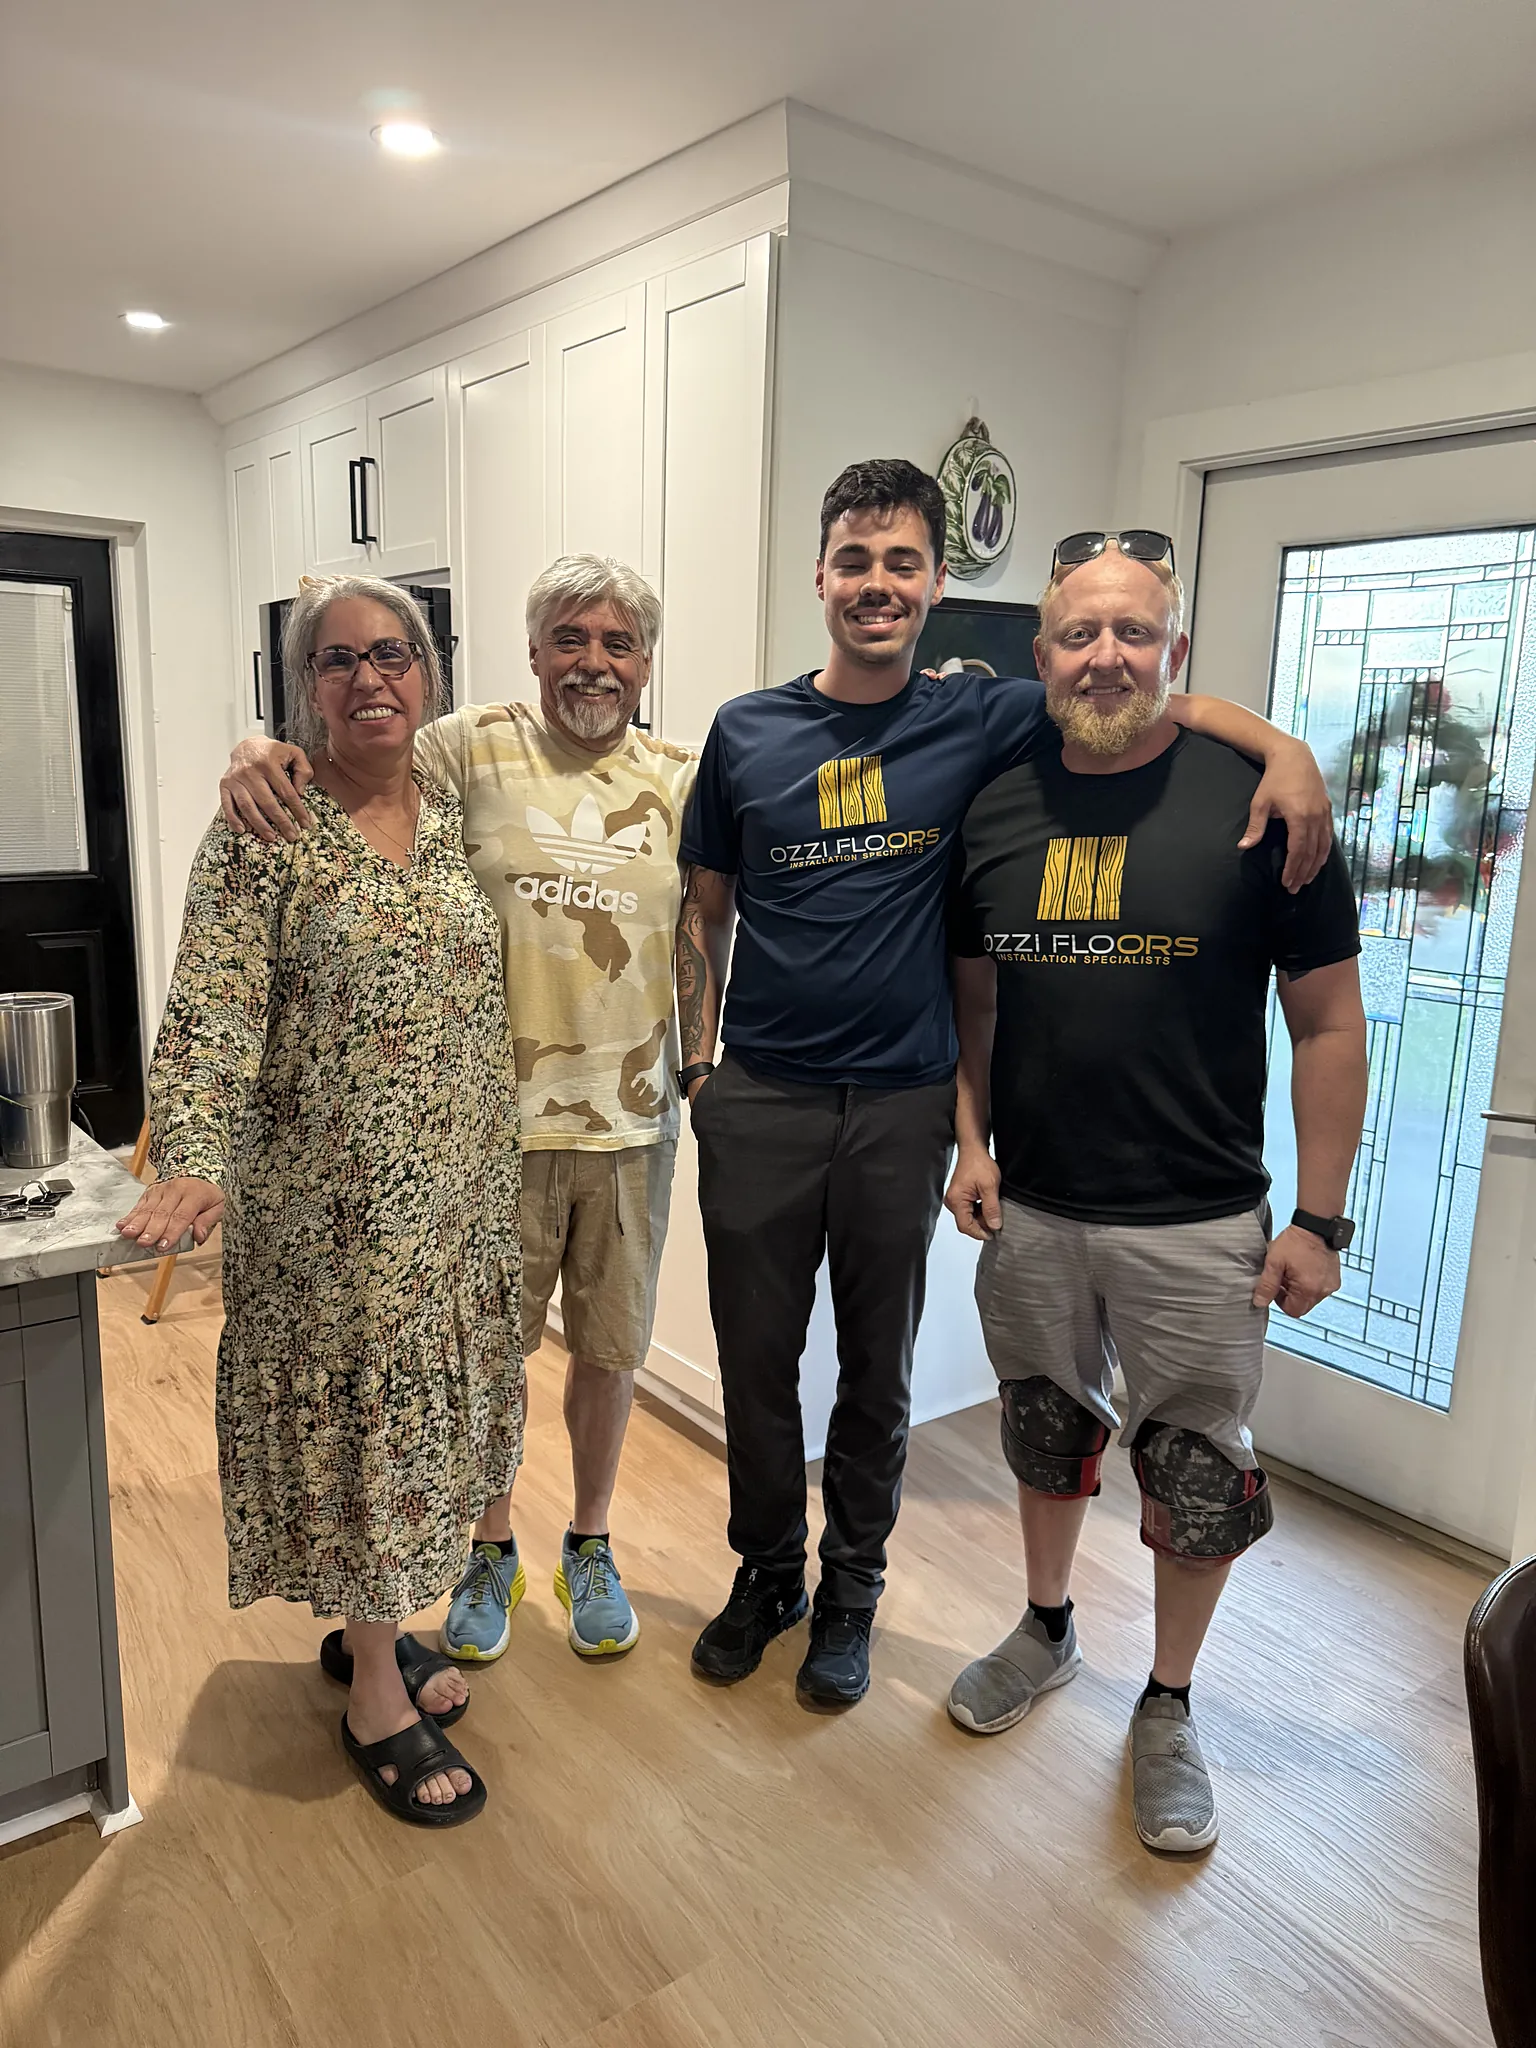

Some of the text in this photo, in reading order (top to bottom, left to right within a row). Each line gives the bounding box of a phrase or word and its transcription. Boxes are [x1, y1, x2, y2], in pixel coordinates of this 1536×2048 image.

[770, 827, 941, 863] OZZI FLOORS
[789, 846, 924, 869] INSTALLATION SPECIALISTS
[514, 875, 638, 914] adidas
[983, 933, 1200, 957] OZZI FLOORS
[996, 953, 1171, 966] INSTALLATION SPECIALISTS
